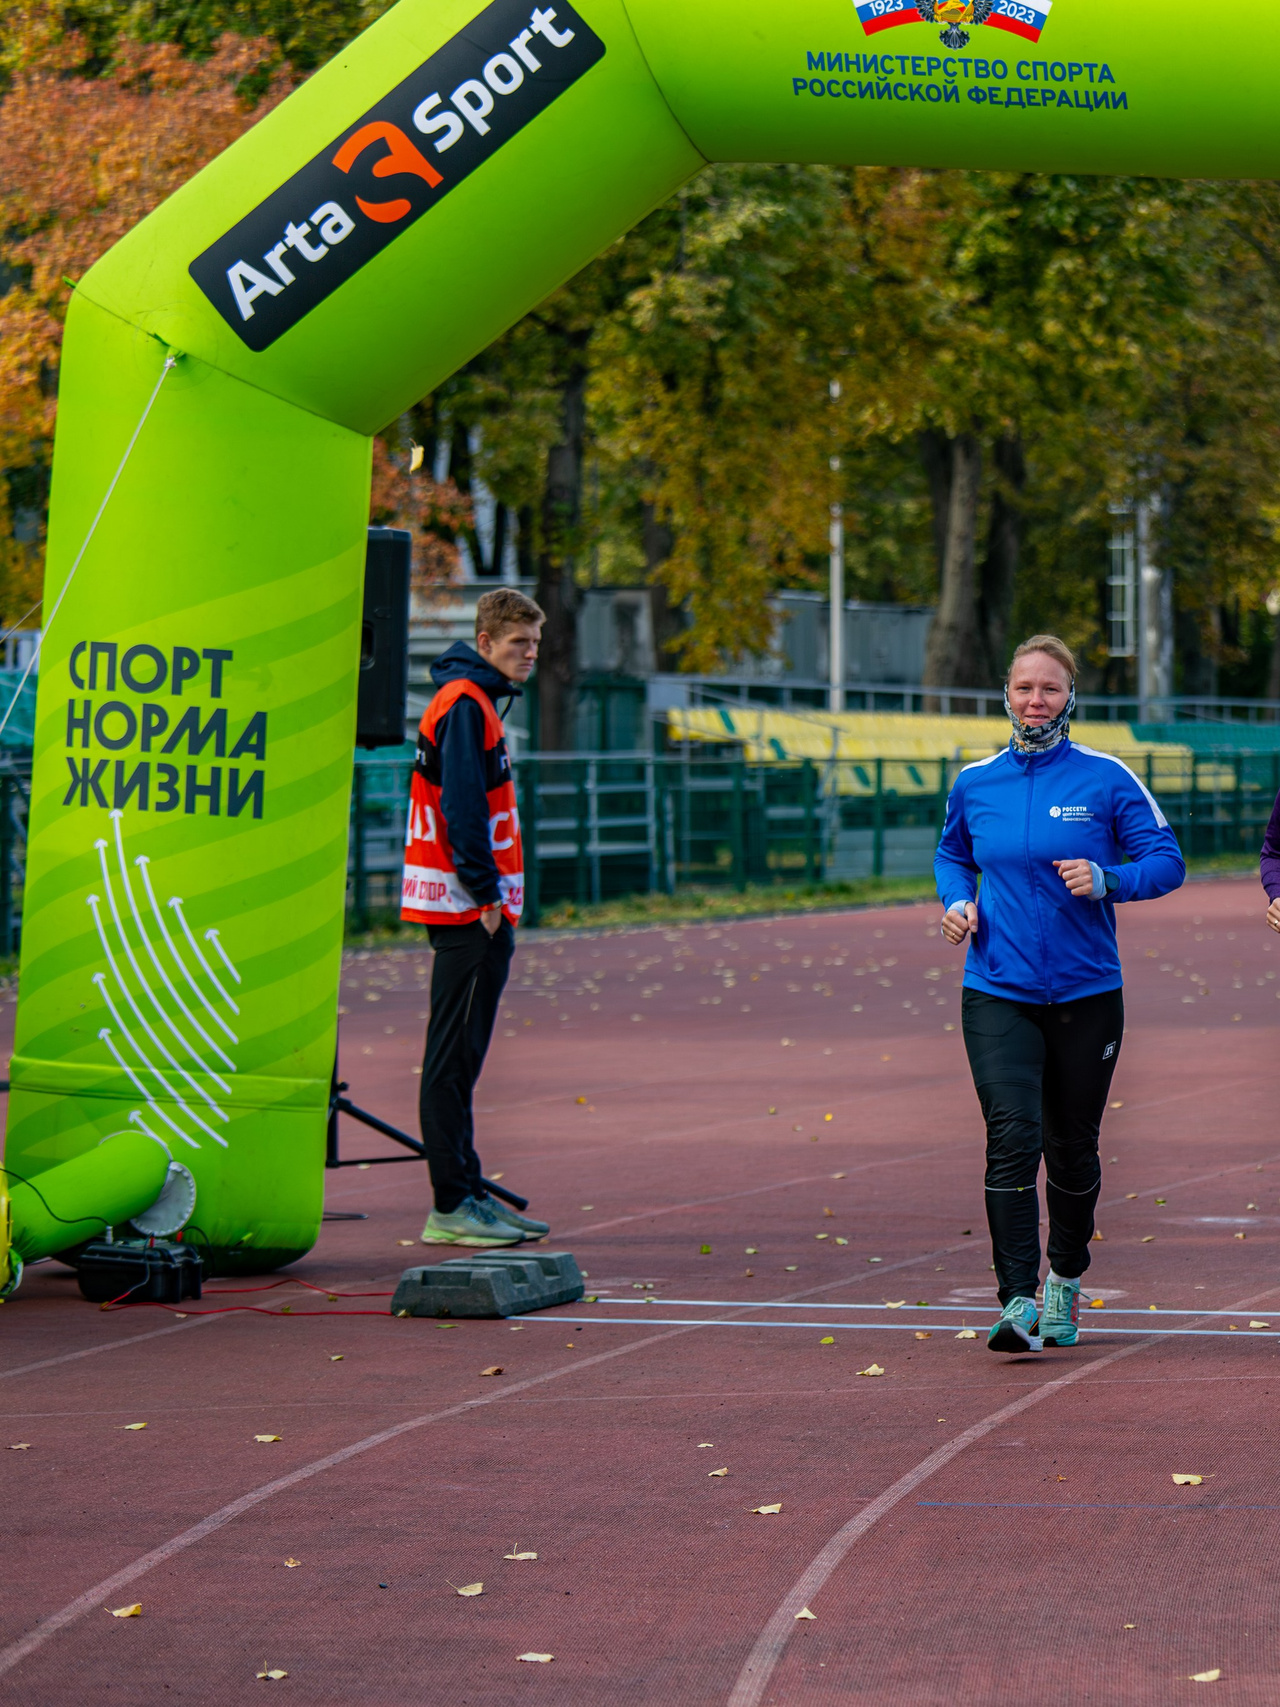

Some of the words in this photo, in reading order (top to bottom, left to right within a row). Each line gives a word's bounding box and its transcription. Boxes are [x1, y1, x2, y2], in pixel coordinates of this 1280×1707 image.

[869, 0, 904, 17] 1923
[997, 1, 1036, 25] 2023
[806, 51, 1009, 79] МИНИСТЕРСТВО
[1016, 60, 1116, 84] СПОРТА
[792, 76, 961, 103] РОССИЙСКОЙ
[967, 86, 1129, 112] ФЕДЕРАЦИИ
[226, 201, 356, 322] Arta
[412, 6, 576, 153] Sport
[69, 640, 233, 699] СПОРТ
[66, 698, 268, 761] НОРМА
[62, 756, 266, 820] ЖИЗНИ
[418, 880, 452, 903] СПОР
